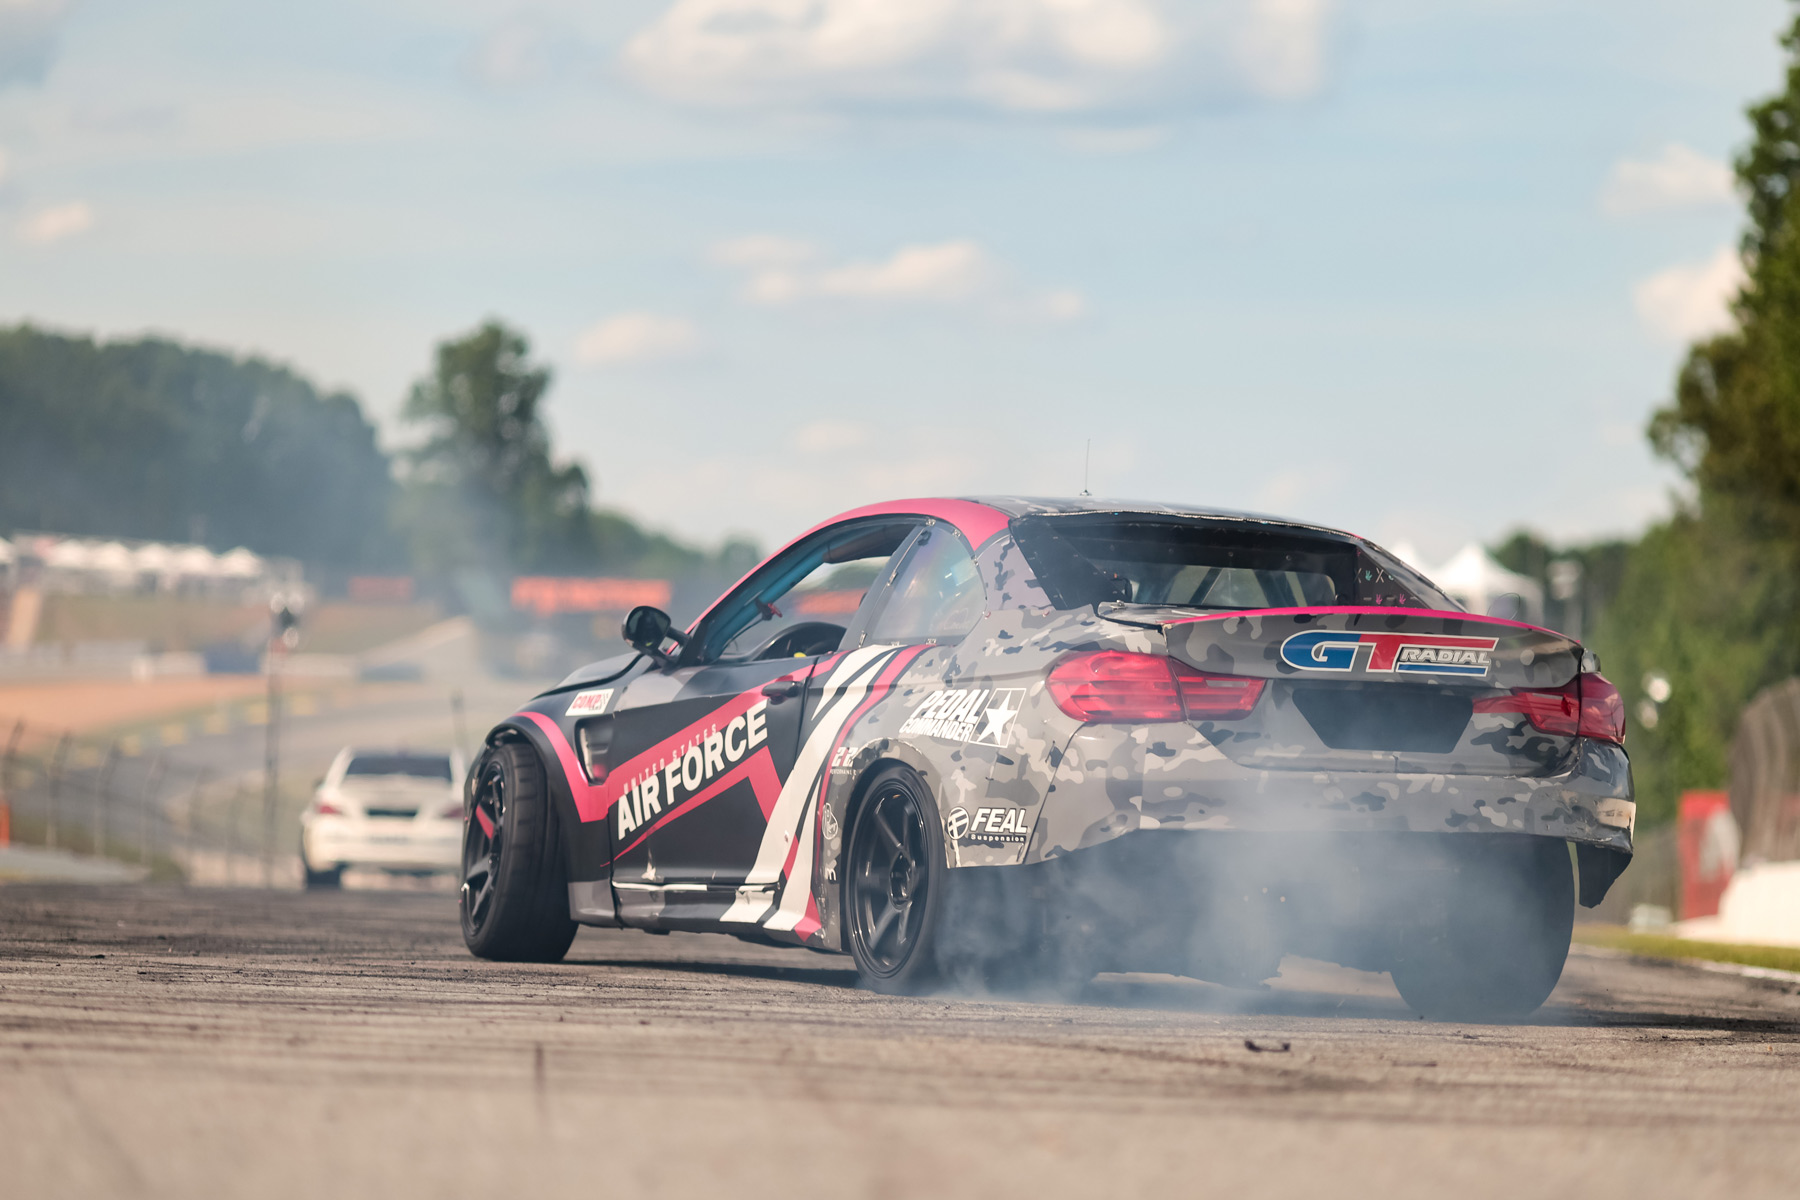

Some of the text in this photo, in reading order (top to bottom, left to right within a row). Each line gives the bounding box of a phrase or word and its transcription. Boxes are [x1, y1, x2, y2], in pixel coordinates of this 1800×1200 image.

[1280, 630, 1499, 672] GT
[1399, 648, 1490, 664] RADIAL
[910, 689, 989, 724] PEDAL
[899, 718, 974, 742] COMMANDER
[618, 699, 768, 840] AIR FORCE
[623, 723, 716, 795] UNITED STATES
[970, 808, 1027, 833] FEAL
[970, 834, 1025, 842] Suspension
